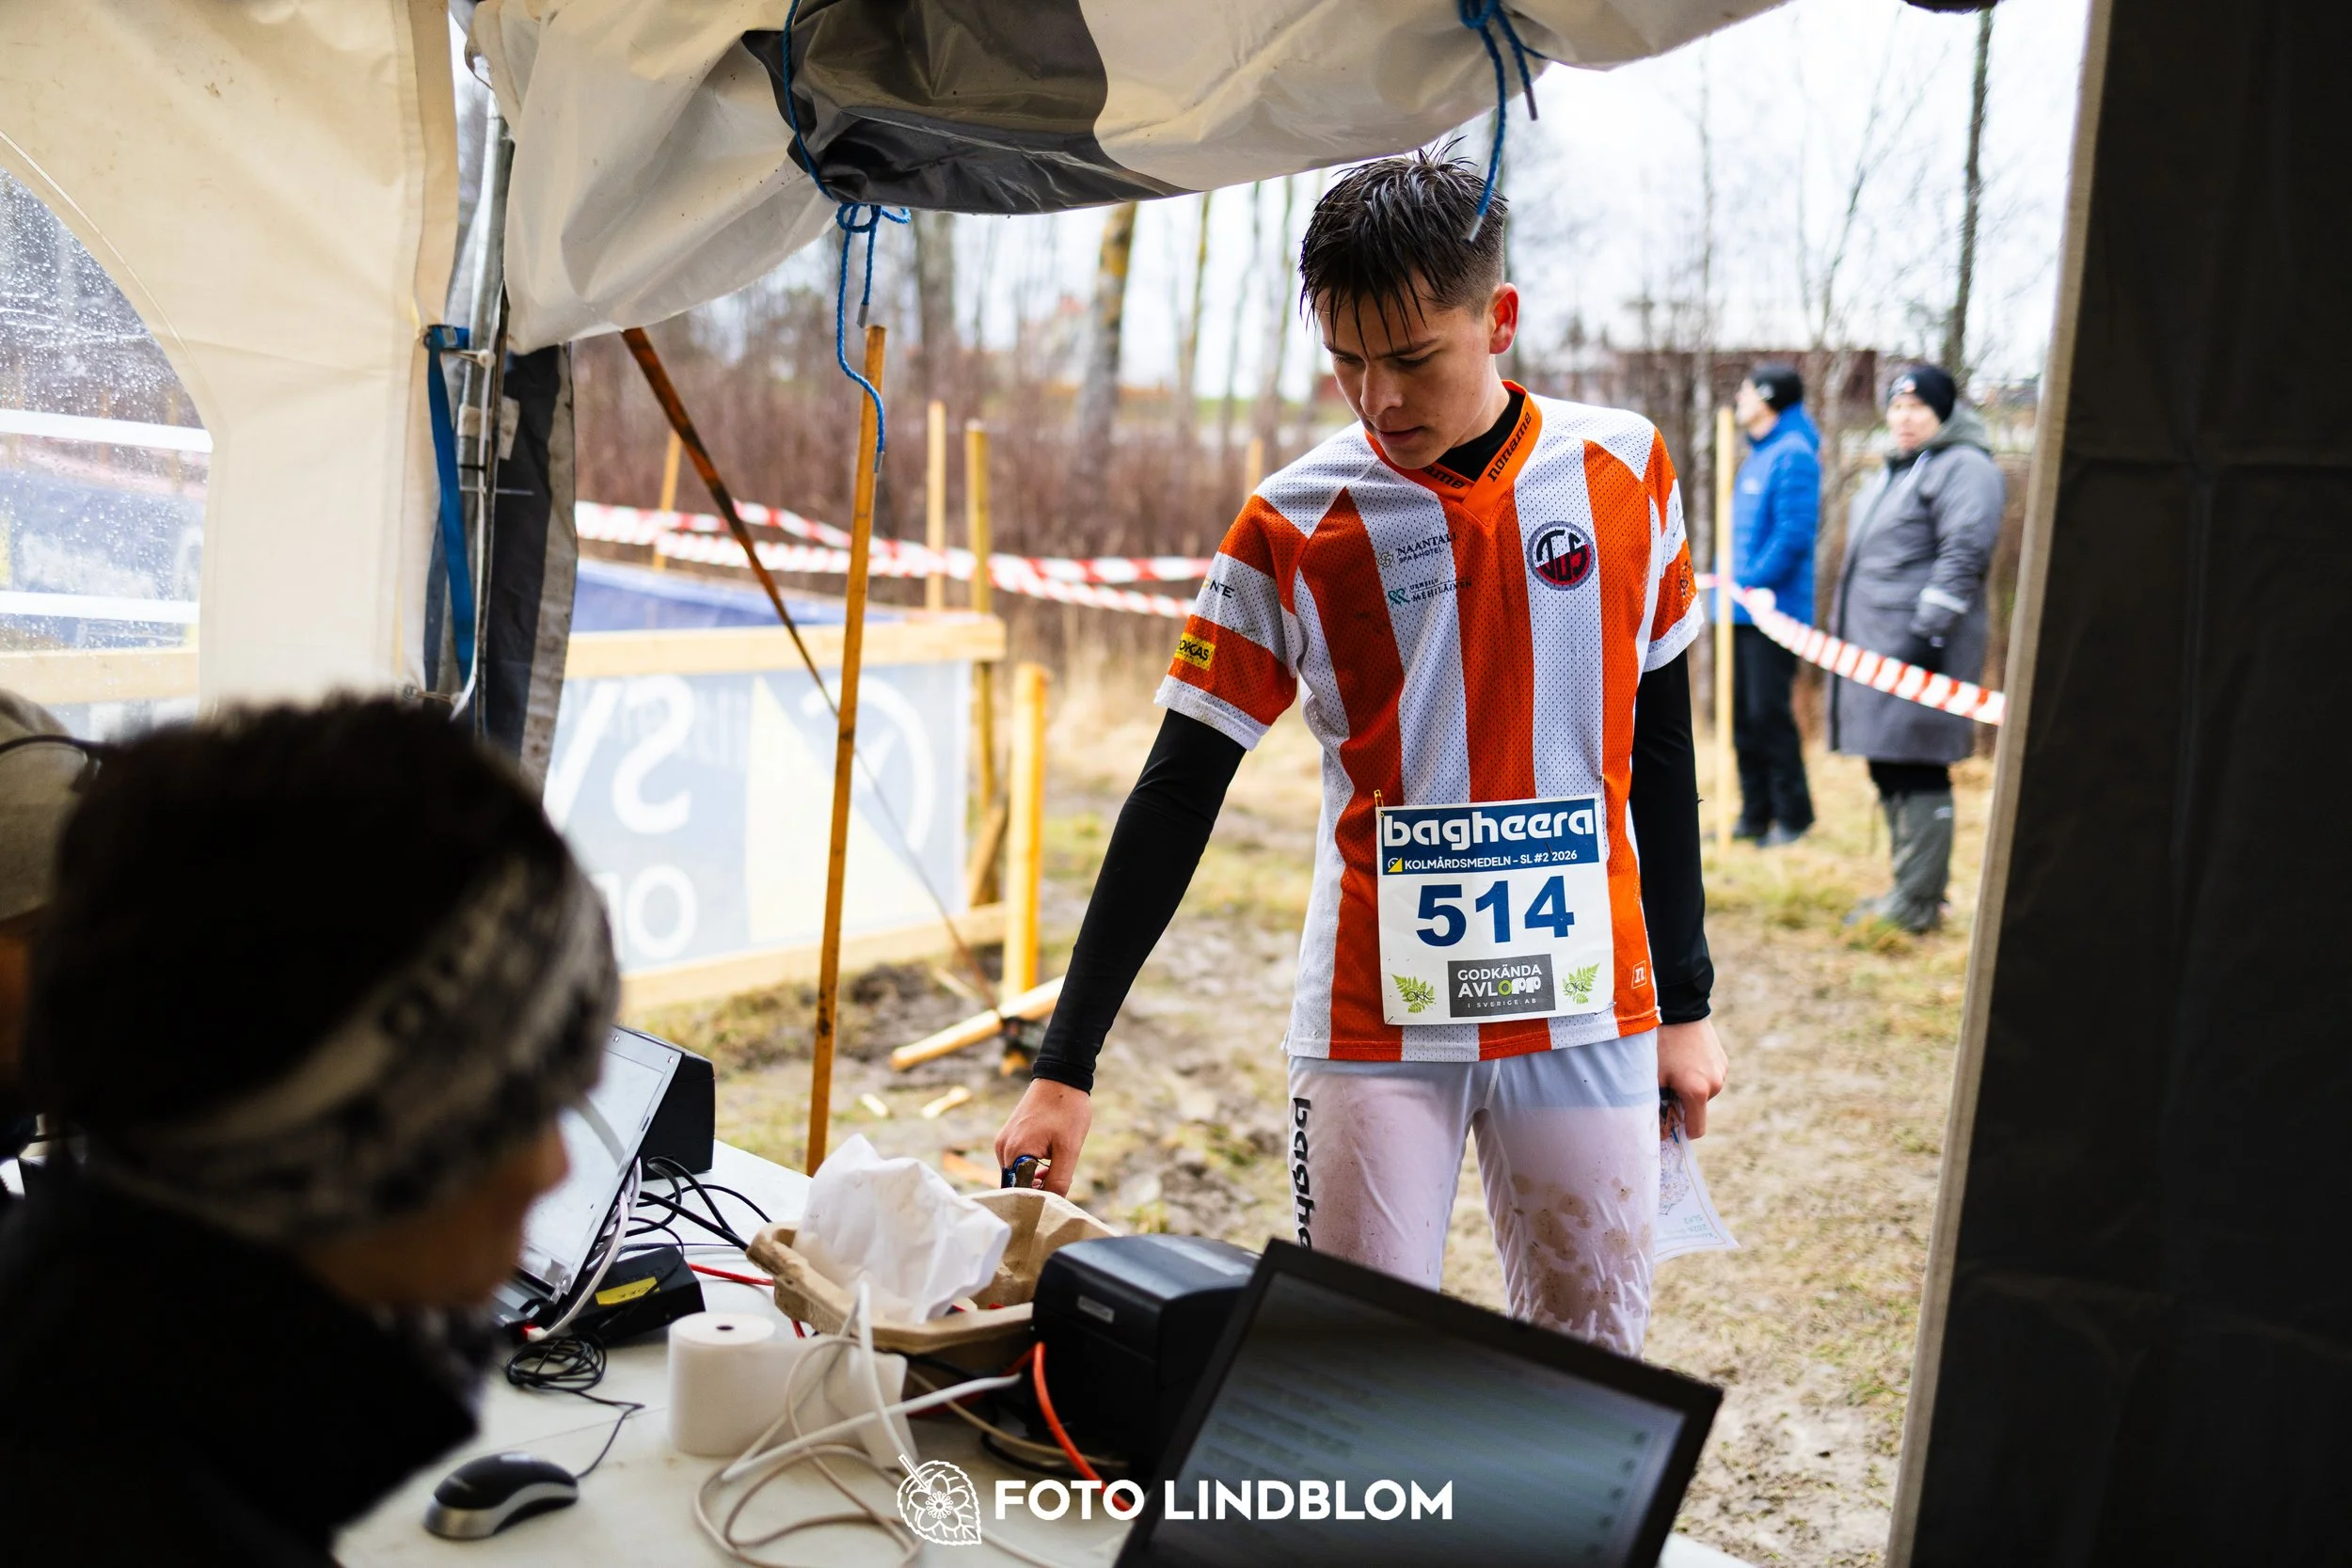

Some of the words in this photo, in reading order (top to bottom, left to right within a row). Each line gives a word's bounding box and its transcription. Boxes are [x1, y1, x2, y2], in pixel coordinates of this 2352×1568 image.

[1487, 412, 1532, 483] noname
[1395, 532, 1456, 556] NAANTALI
[1384, 809, 1595, 850] bagheera
[1405, 854, 1511, 870] KOLMÅRDSMEDELN
[1520, 854, 1533, 864] SL
[1534, 852, 1549, 863] #2
[1551, 850, 1578, 862] 2026
[1416, 875, 1575, 947] 514
[1457, 964, 1542, 981] GODKÄNDA
[1476, 999, 1518, 1008] SVERIGE
